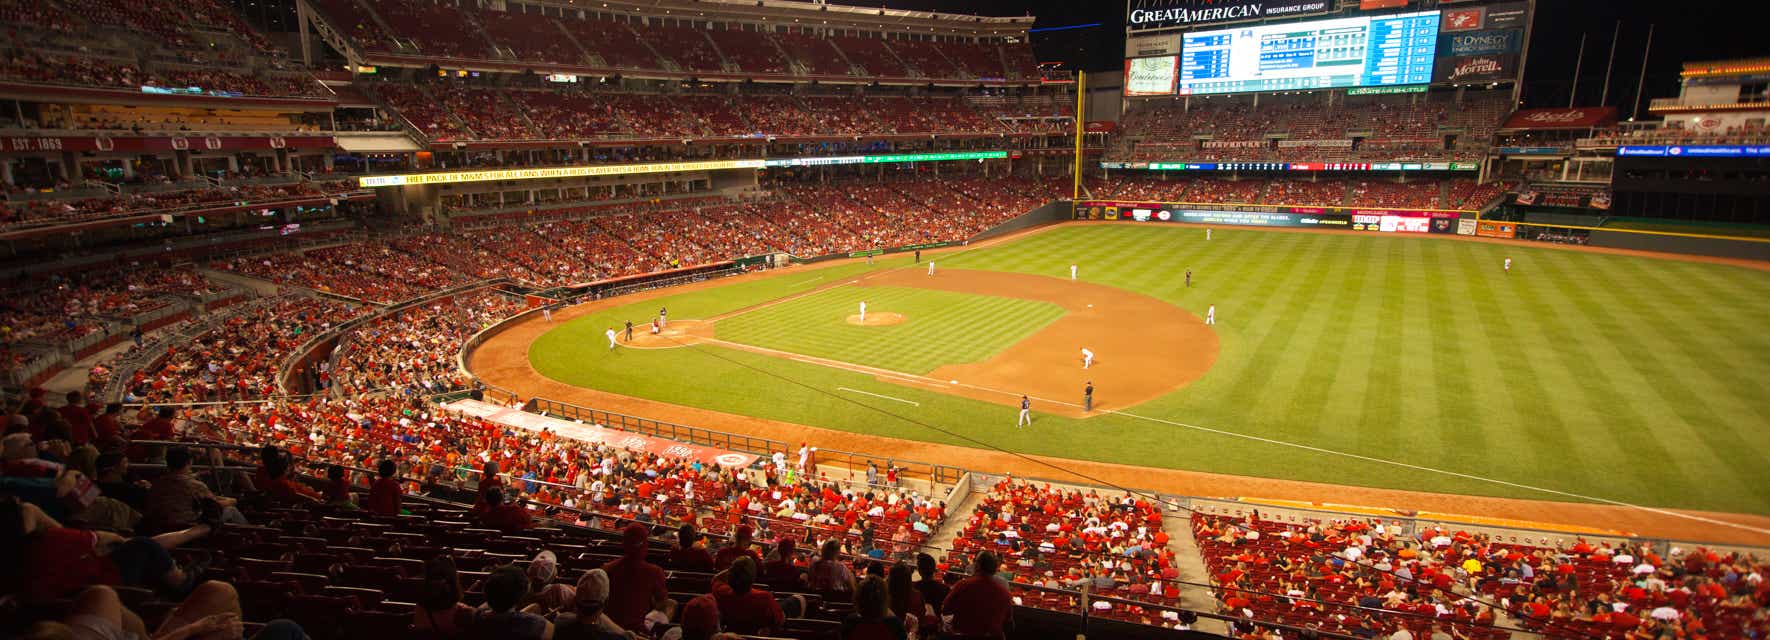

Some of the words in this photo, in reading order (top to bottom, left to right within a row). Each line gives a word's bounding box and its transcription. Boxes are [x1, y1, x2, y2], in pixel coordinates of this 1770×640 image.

[1130, 8, 1184, 24] GREAT
[1176, 3, 1262, 24] AMERICAN
[1266, 5, 1301, 15] INSURANCE
[1302, 2, 1325, 11] GROUP
